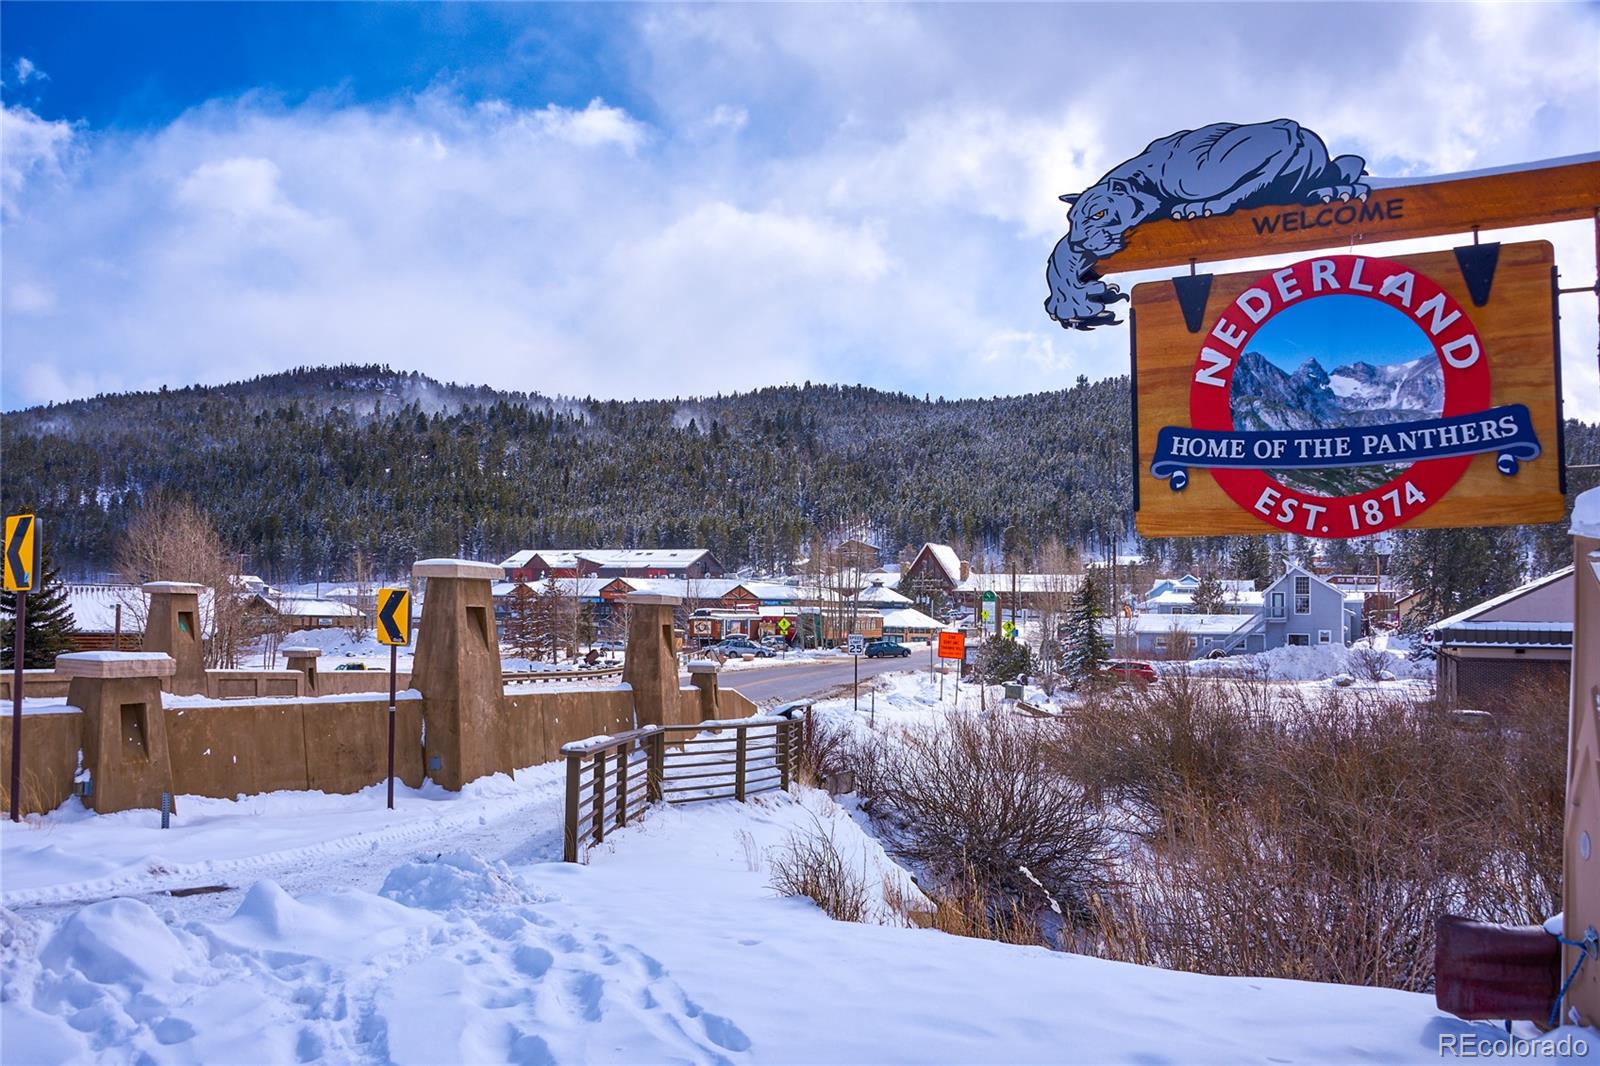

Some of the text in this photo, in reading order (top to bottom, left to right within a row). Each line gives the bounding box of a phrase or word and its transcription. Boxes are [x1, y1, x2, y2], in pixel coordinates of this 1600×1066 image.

[1251, 198, 1405, 235] WELCOME
[1195, 258, 1480, 388] NEDERLAND
[1170, 415, 1519, 459] HOME OF THE PANTHERS
[1254, 480, 1426, 533] EST. 1874
[849, 644, 862, 653] 25
